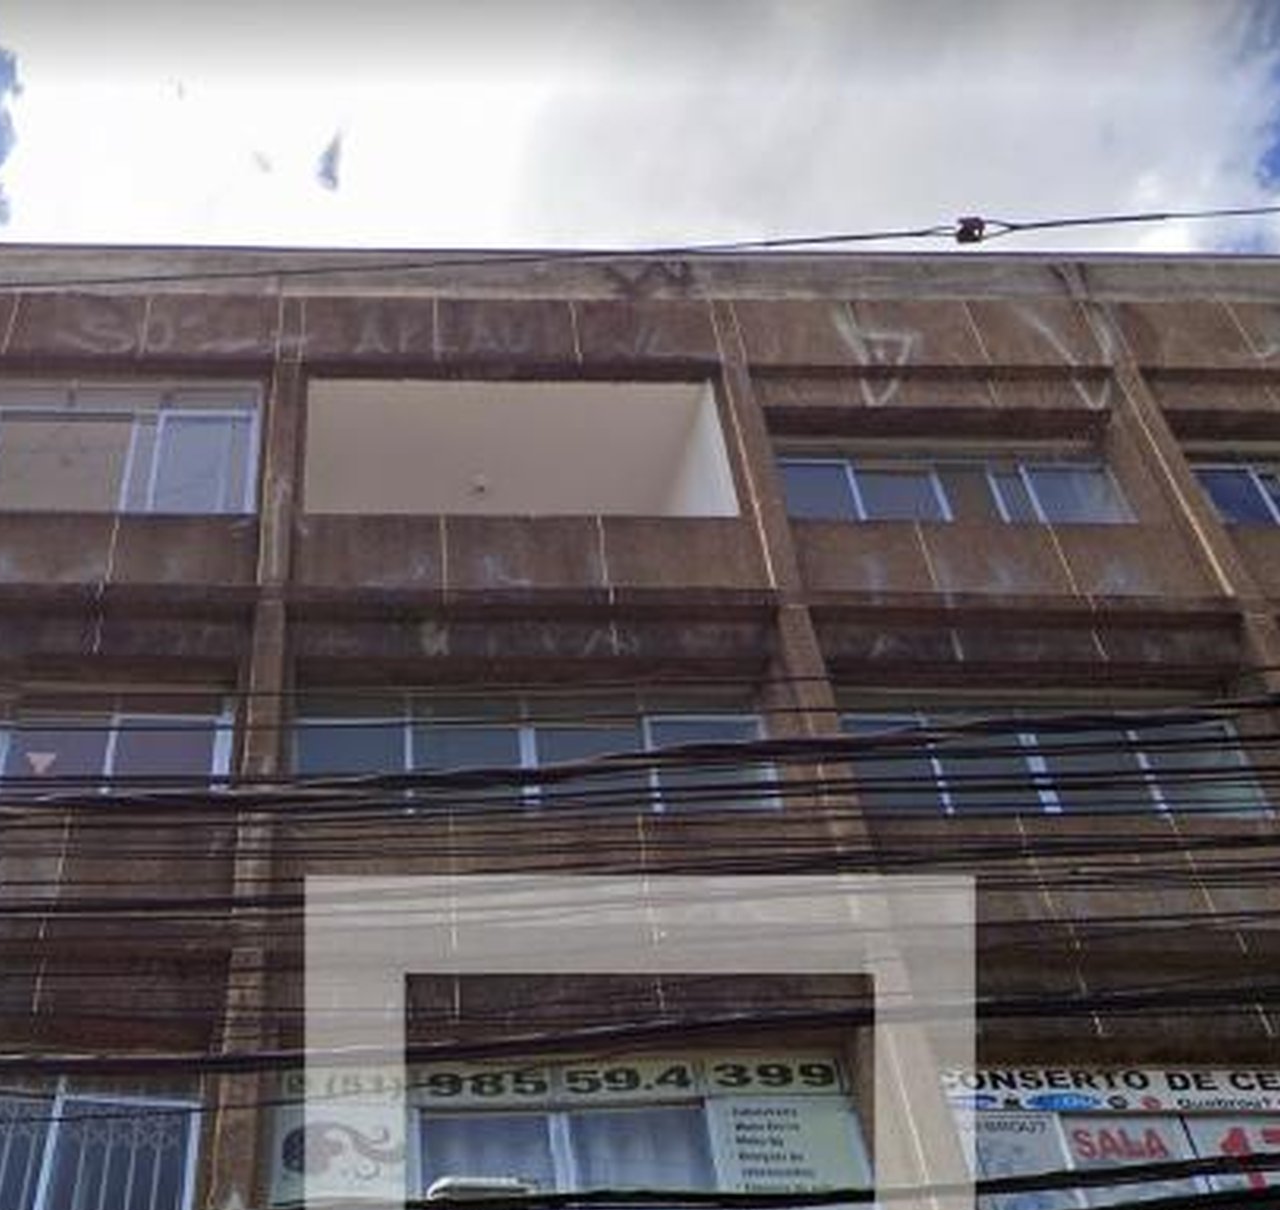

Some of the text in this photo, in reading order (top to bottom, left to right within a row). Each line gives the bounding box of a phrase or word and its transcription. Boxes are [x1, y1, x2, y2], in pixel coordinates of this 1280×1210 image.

[713, 1062, 838, 1090] 399
[1164, 1072, 1219, 1092] DE
[1071, 1126, 1171, 1161] SALA
